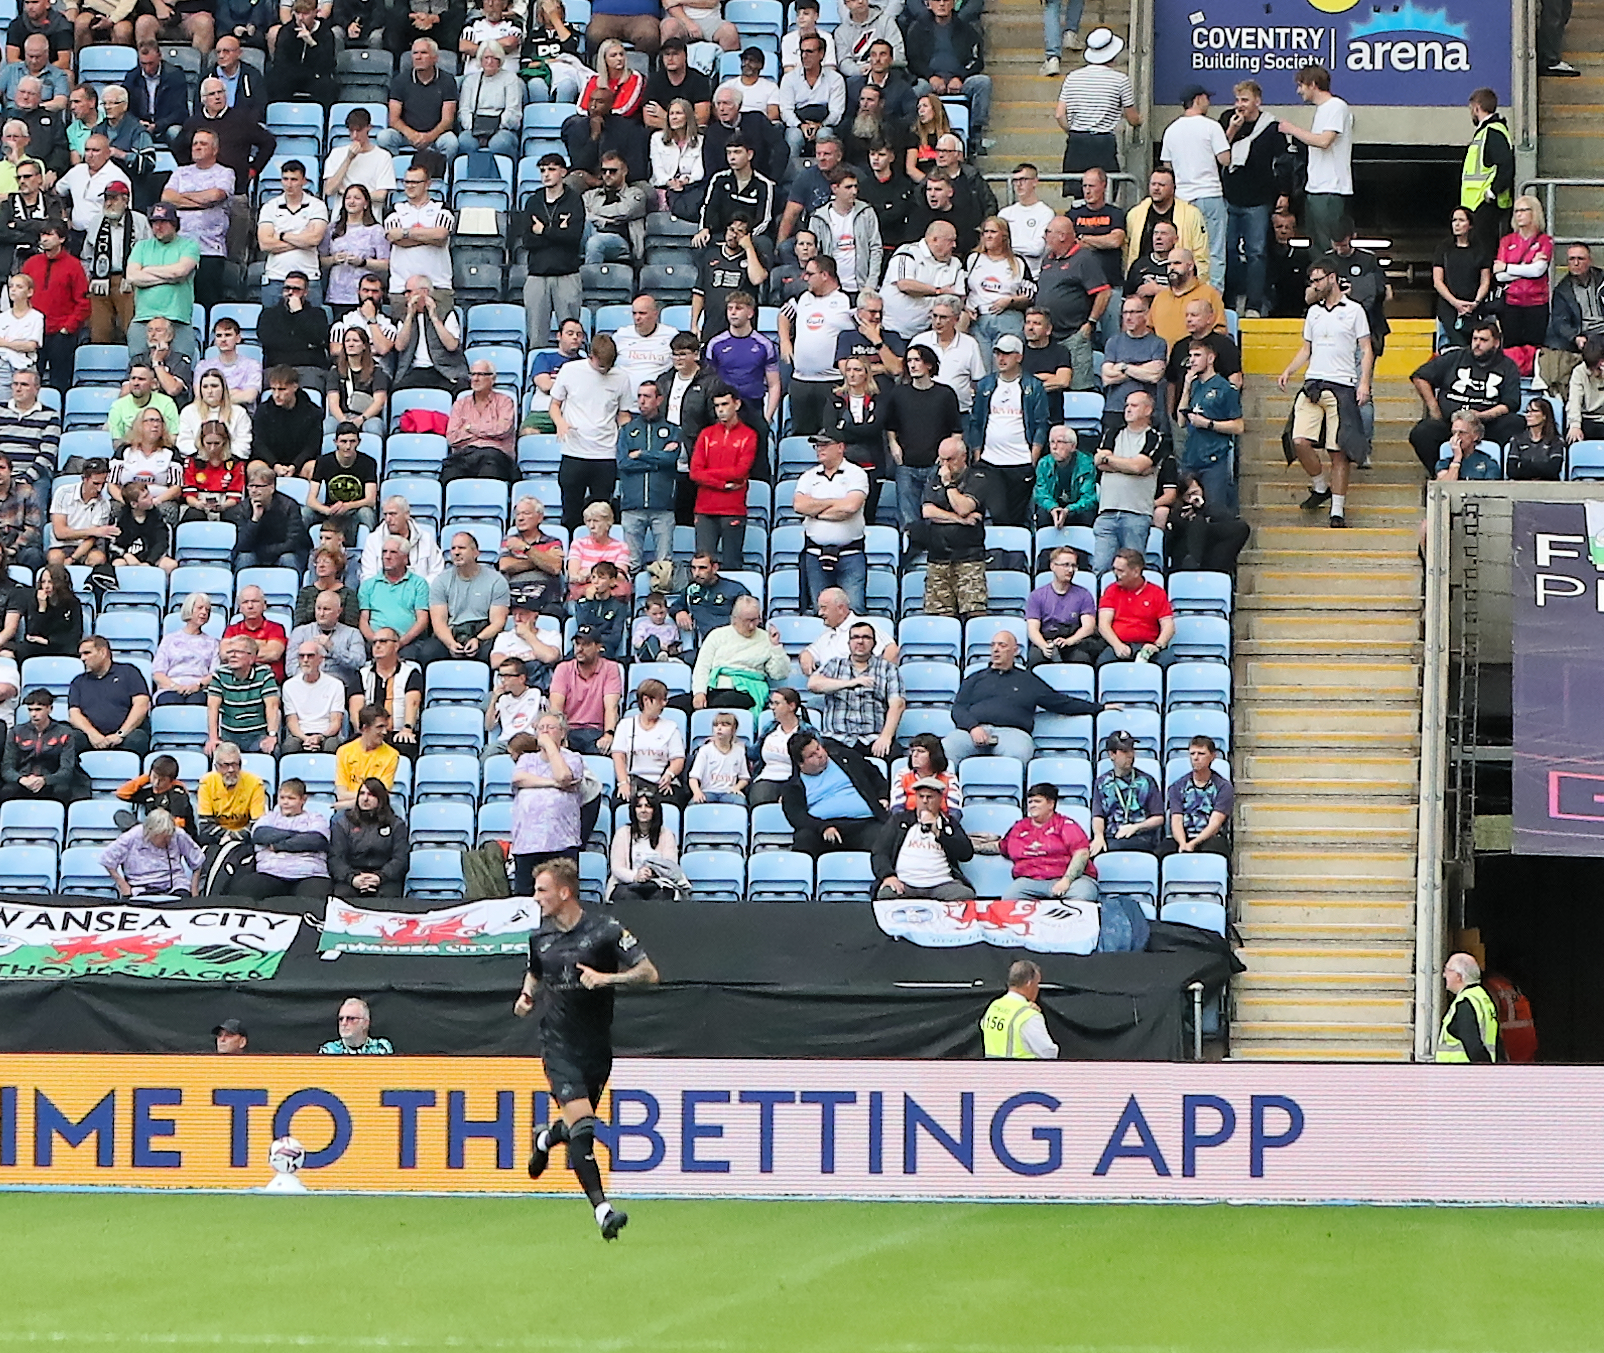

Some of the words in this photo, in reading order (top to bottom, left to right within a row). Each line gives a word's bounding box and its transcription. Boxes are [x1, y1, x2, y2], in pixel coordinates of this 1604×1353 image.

[1192, 27, 1325, 50] COVENTRY
[1346, 39, 1472, 72] arena
[1192, 52, 1261, 74] Building
[1263, 52, 1325, 71] Society
[628, 350, 666, 362] Reviva
[189, 912, 289, 931] CITY
[445, 943, 496, 954] CITY
[986, 1016, 1006, 1032] 156
[213, 1087, 352, 1169] TO
[609, 1090, 1064, 1176] BETTING
[1092, 1092, 1306, 1179] APP
